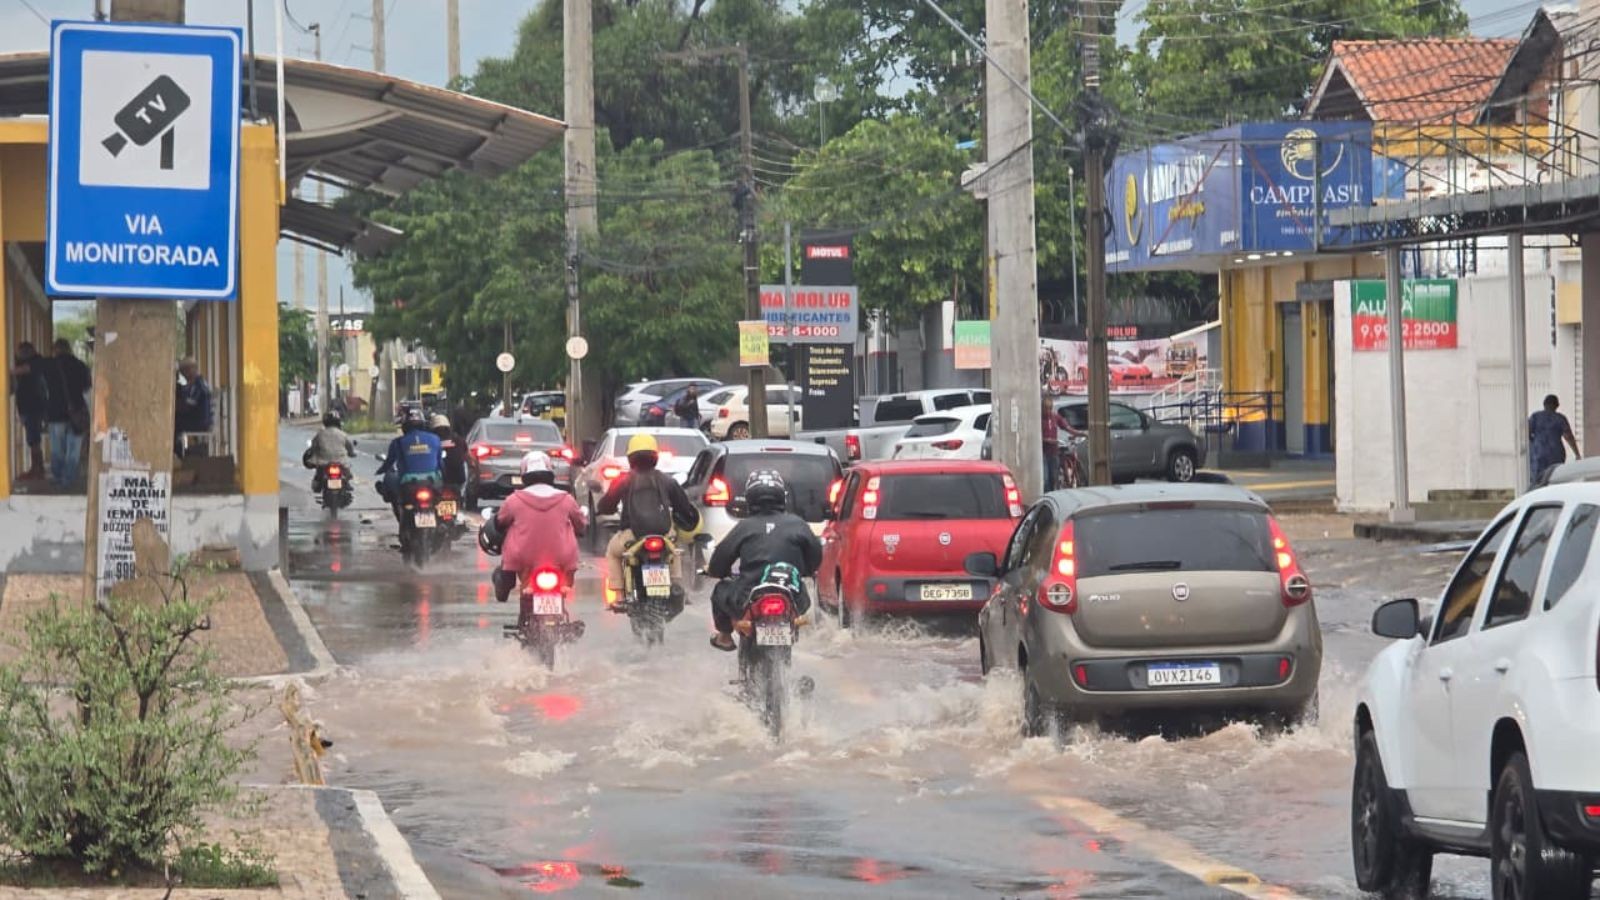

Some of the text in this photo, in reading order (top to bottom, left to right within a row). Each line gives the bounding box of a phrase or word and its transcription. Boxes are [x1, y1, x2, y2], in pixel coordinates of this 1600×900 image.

[134, 93, 168, 124] TV
[125, 213, 163, 234] VIA
[64, 243, 219, 267] MONITORADA
[811, 247, 841, 257] MOTUL
[1357, 300, 1413, 315] ALUA
[1360, 322, 1449, 338] 9.992.2500
[132, 500, 149, 508] DE
